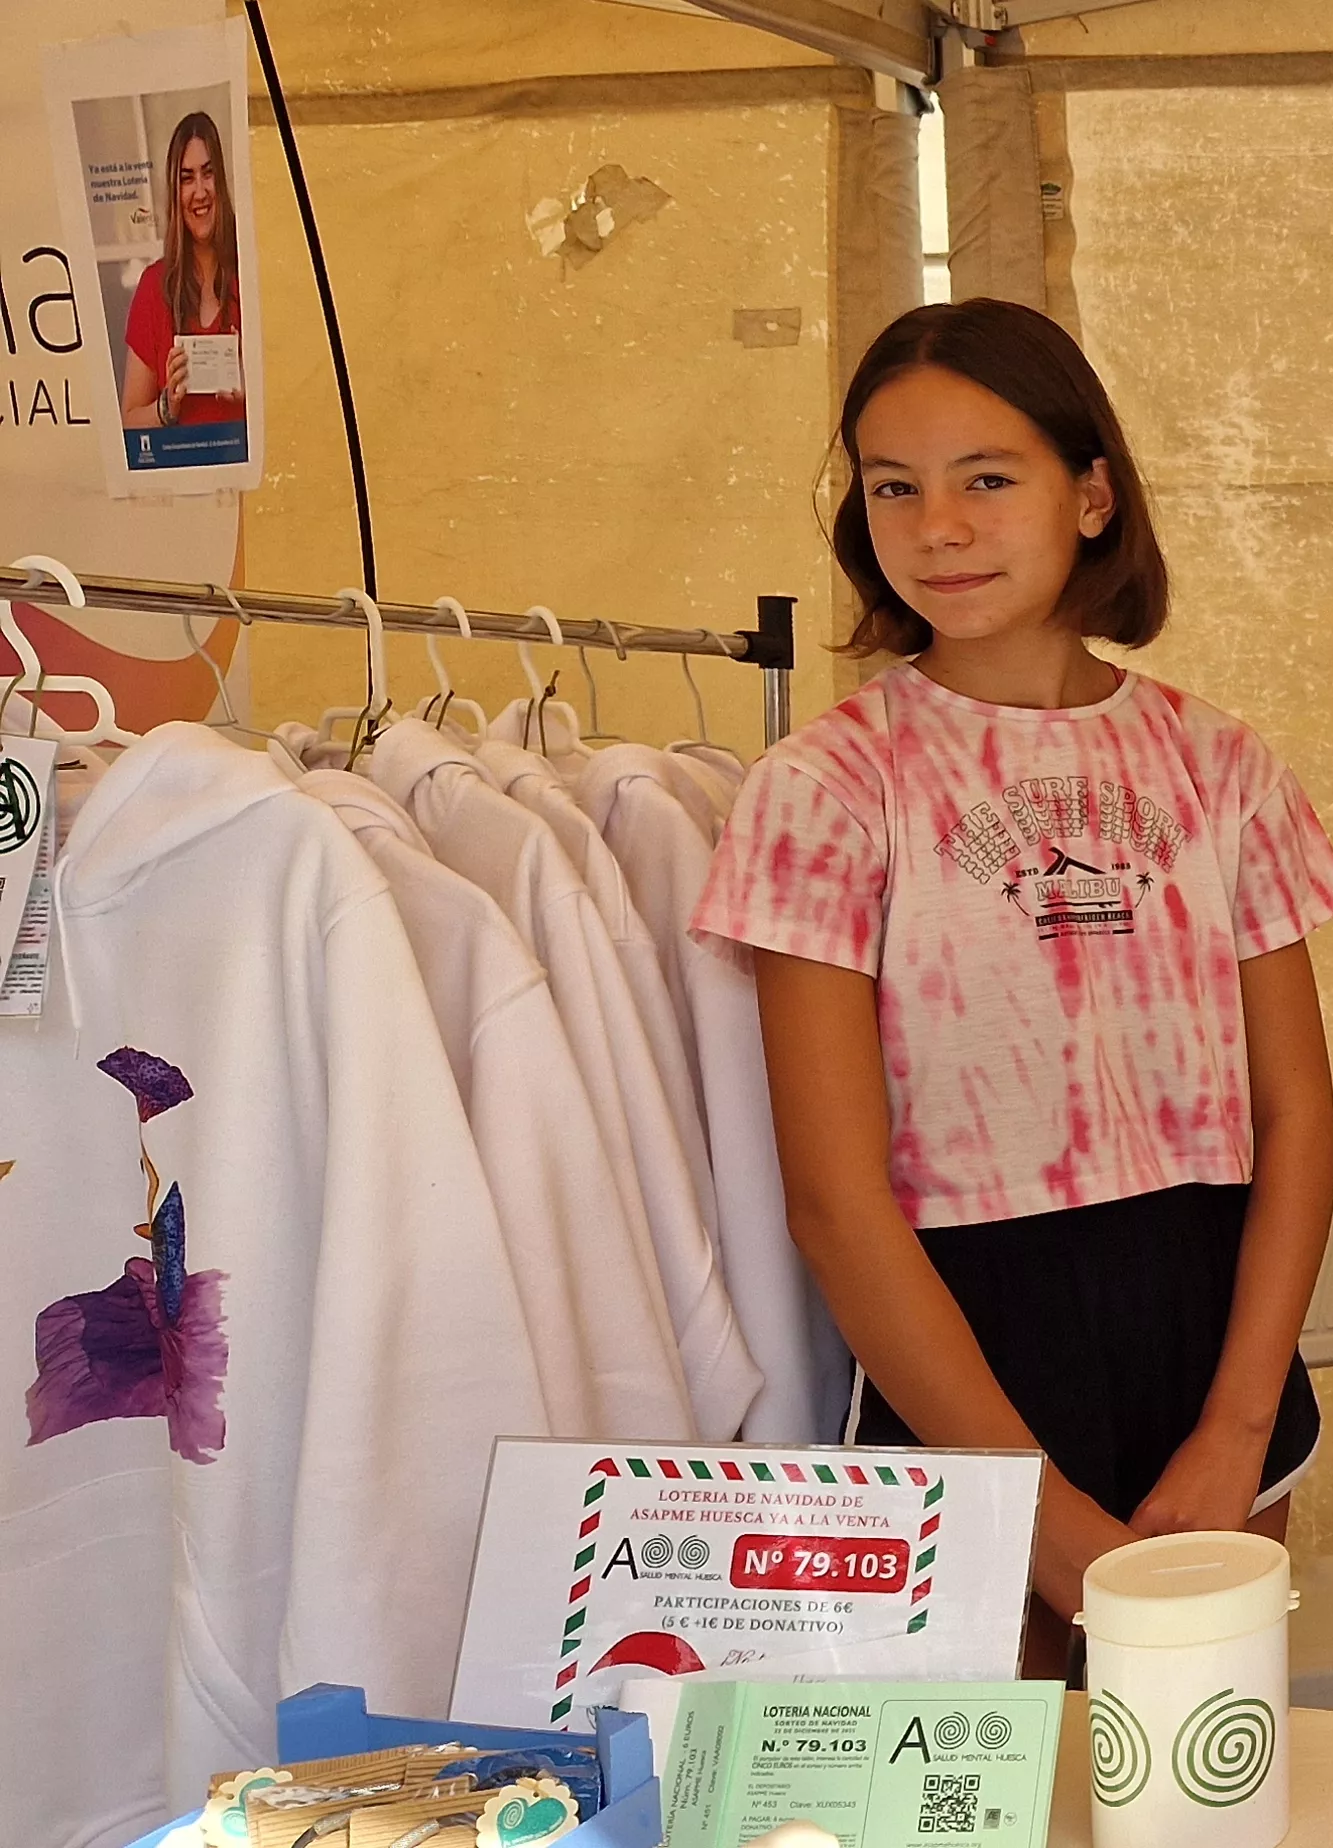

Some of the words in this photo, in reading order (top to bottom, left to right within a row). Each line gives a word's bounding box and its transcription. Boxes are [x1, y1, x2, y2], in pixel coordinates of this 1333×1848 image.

[93, 193, 104, 203] de
[0, 379, 90, 426] IAL
[933, 801, 1021, 884] THE
[1002, 776, 1088, 846] SURF
[1100, 781, 1193, 873] SPORT
[1035, 878, 1121, 901] MALIBU
[658, 1489, 729, 1504] LOTERIA
[734, 1492, 757, 1505] DE
[760, 1492, 837, 1508] NAVIDAD
[841, 1495, 864, 1509] DE
[630, 1508, 695, 1522] ASAPME
[700, 1510, 764, 1525] HUESCA
[769, 1512, 790, 1525] YA
[794, 1513, 805, 1525] A
[809, 1513, 831, 1526] LA
[835, 1514, 890, 1528] VENTA
[743, 1549, 784, 1575] Nº
[793, 1551, 898, 1579] 79.103
[640, 1571, 662, 1579] SALUD
[665, 1572, 692, 1580] MENTAL
[695, 1573, 723, 1581] HUESCA
[653, 1595, 802, 1613] PARTICIPACIONES
[807, 1601, 829, 1613] DE
[833, 1602, 853, 1614] 6€
[661, 1616, 675, 1629] (5
[679, 1615, 690, 1628] €
[722, 1617, 745, 1630] DE
[749, 1618, 844, 1634] DONATIVO)
[812, 1705, 871, 1718] NACIONAL
[796, 1739, 867, 1752] 79.103
[671, 1758, 687, 1808] NACIONAL
[683, 1711, 695, 1741] EUROS
[996, 1754, 1027, 1762] HUESCA
